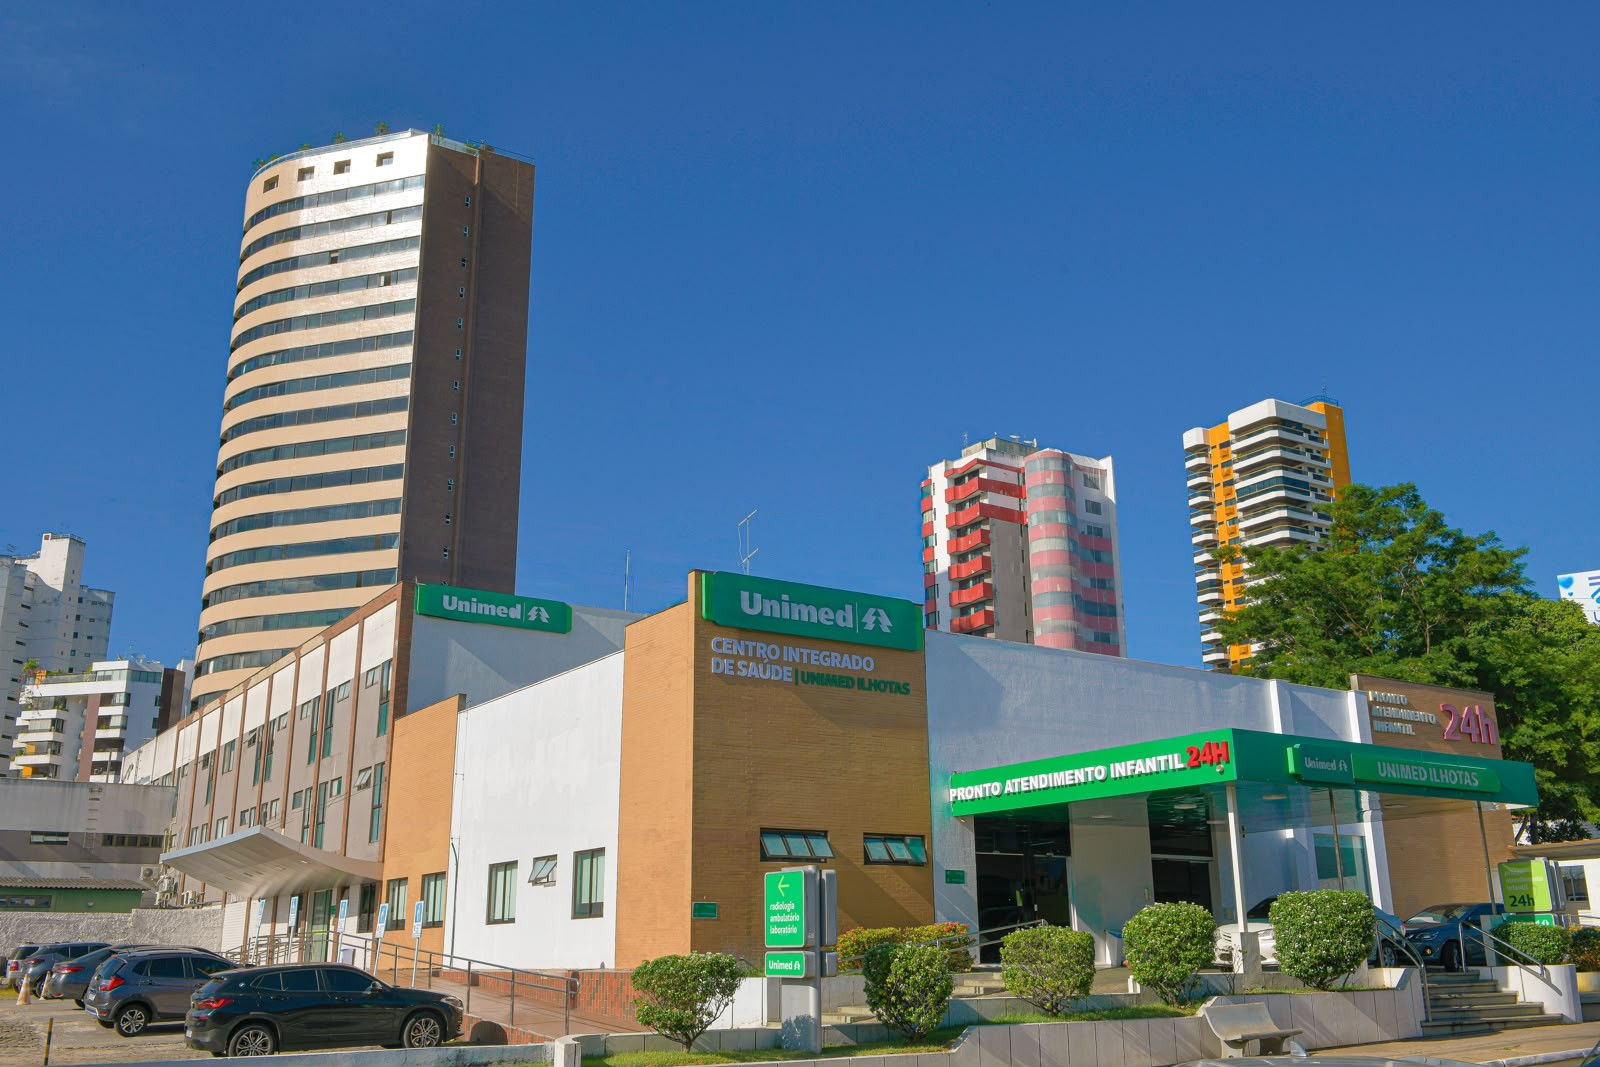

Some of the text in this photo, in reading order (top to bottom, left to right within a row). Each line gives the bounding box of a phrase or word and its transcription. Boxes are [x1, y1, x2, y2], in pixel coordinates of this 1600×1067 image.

[442, 595, 521, 619] Unimed
[740, 590, 853, 628] Unimed
[711, 637, 875, 672] CENTRO INTEGRADO
[711, 657, 793, 682] DE SAÚDE
[801, 671, 910, 695] UNIMED ILHOTAS
[1369, 690, 1409, 706] PRONTO
[1371, 705, 1437, 725] ATENDIMENTO
[1439, 703, 1497, 745] 24h
[1373, 719, 1416, 736] INFANTIL
[949, 741, 1230, 802] PRONTO ATENDIMENTO INFANTIL 24H
[1304, 757, 1337, 771] Unimed
[1377, 761, 1479, 787] UNIMED ILHOTAS
[770, 901, 795, 912] radiologia
[1509, 894, 1535, 907] 24h
[770, 912, 800, 922] ambulatório
[770, 924, 798, 934] laboratório
[769, 960, 793, 970] Unimed
